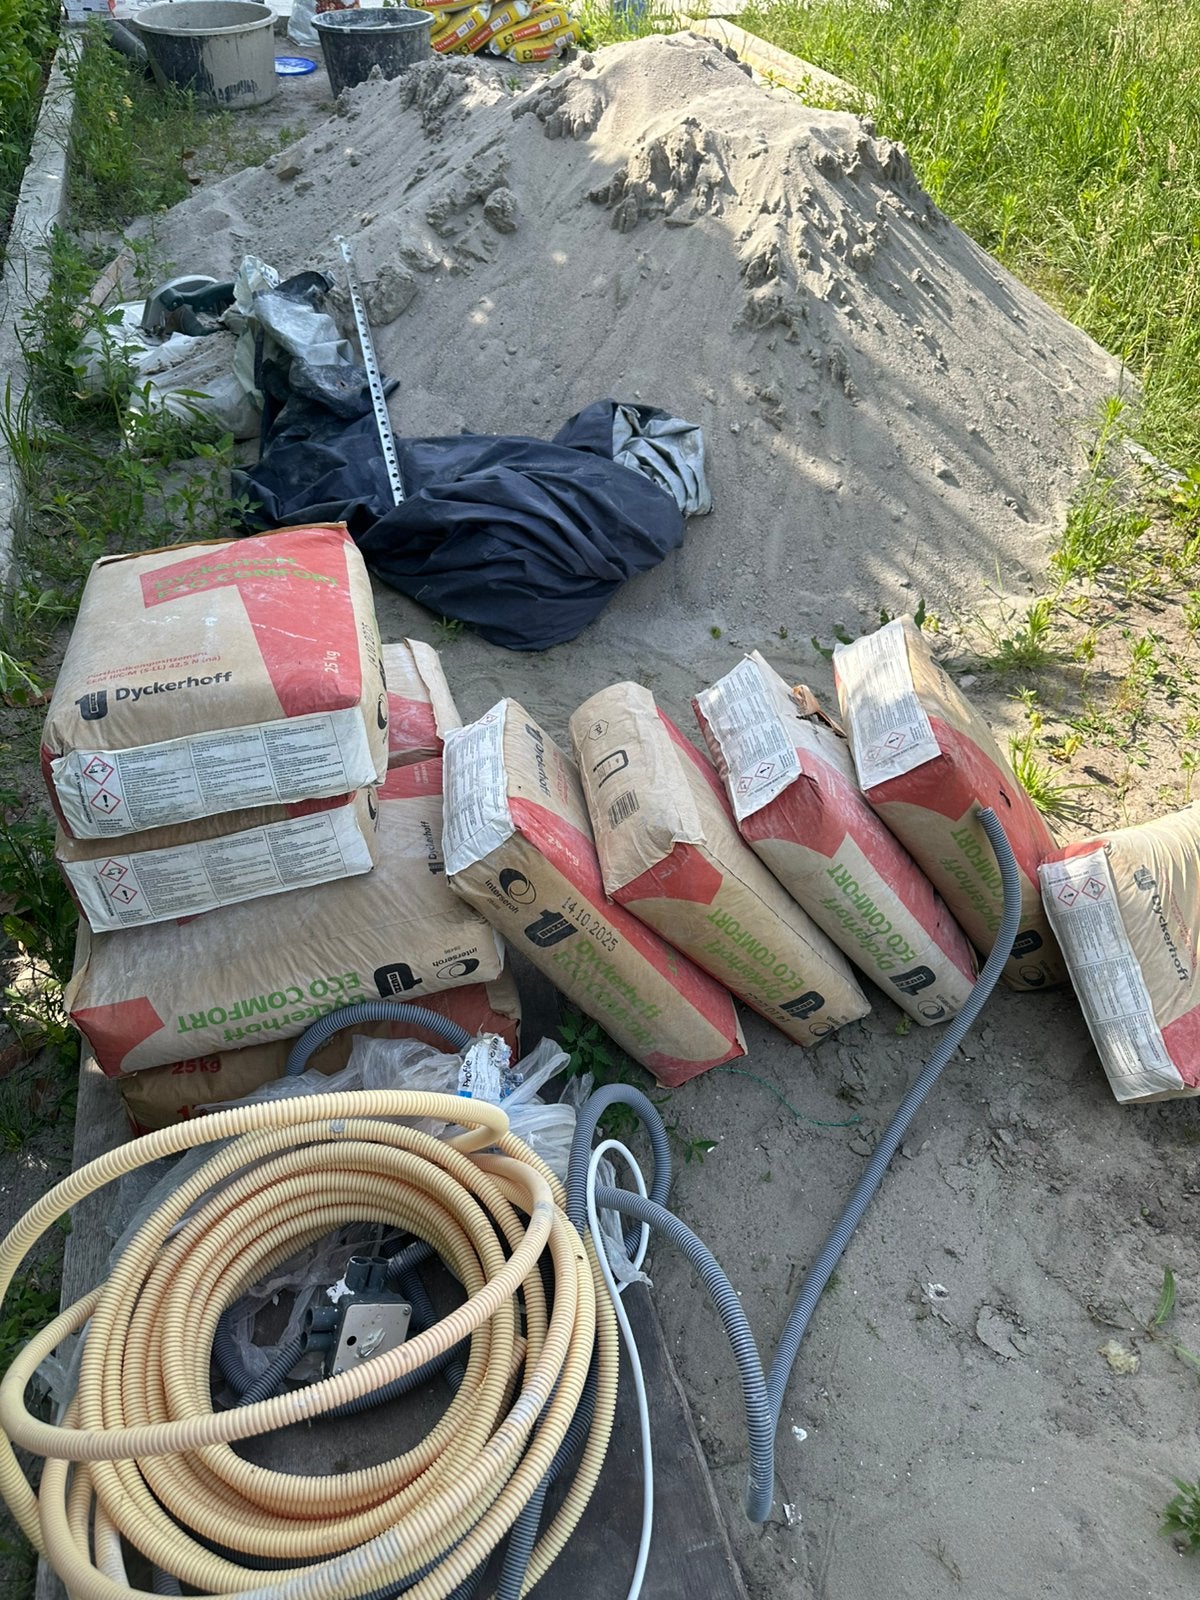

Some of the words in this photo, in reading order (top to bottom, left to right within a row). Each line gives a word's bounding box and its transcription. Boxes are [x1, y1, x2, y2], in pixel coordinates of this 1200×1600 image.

[323, 650, 341, 662] kg
[324, 661, 339, 674] 25
[115, 671, 233, 702] Dyckerhoff
[485, 879, 519, 913] interseroh
[826, 863, 892, 935] COMFORT
[540, 919, 568, 938] BUZZI
[560, 897, 618, 951] 14.10.2025
[706, 908, 776, 967] COMFORT
[819, 897, 896, 971] Dyckerhoff
[1152, 893, 1189, 982] Dyckerhoff
[433, 946, 479, 969] interseroh
[886, 933, 917, 965] ECO
[309, 972, 361, 996] ECO
[576, 940, 662, 1019] Dyckerhoff
[704, 939, 784, 1000] Dyckerhoff
[773, 963, 806, 992] ECO
[175, 986, 303, 1035] COMFORT
[171, 1060, 197, 1075] 25
[198, 1056, 221, 1073] kg
